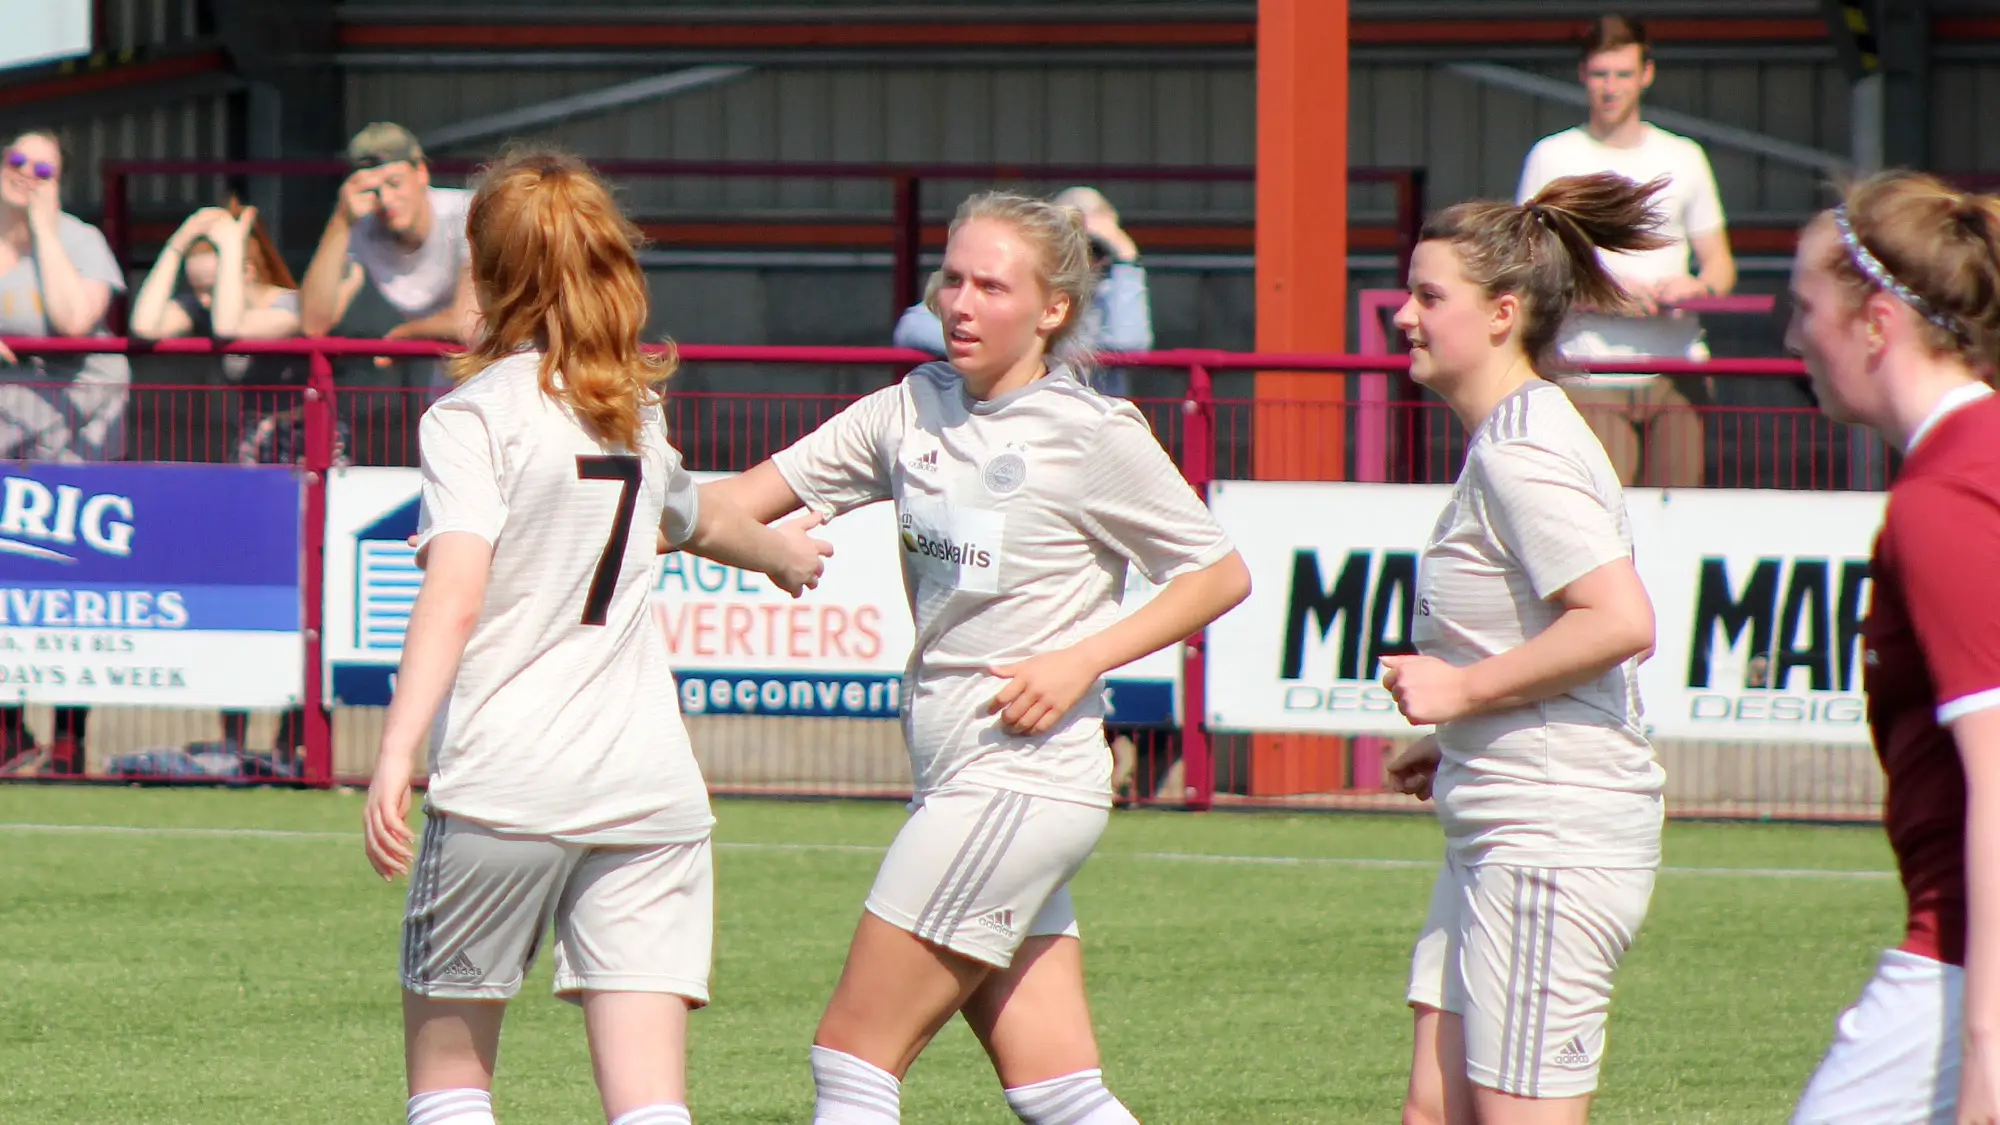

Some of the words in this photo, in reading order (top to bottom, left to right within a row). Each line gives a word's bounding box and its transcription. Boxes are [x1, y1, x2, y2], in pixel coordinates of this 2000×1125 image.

[0, 475, 135, 557] RIG
[576, 455, 642, 626] 7
[917, 534, 991, 568] Boskalis
[77, 666, 97, 686] A
[106, 666, 187, 688] WEEK
[1690, 695, 1864, 723] DESIG
[444, 963, 482, 976] adidas
[1554, 1054, 1589, 1064] adidas
